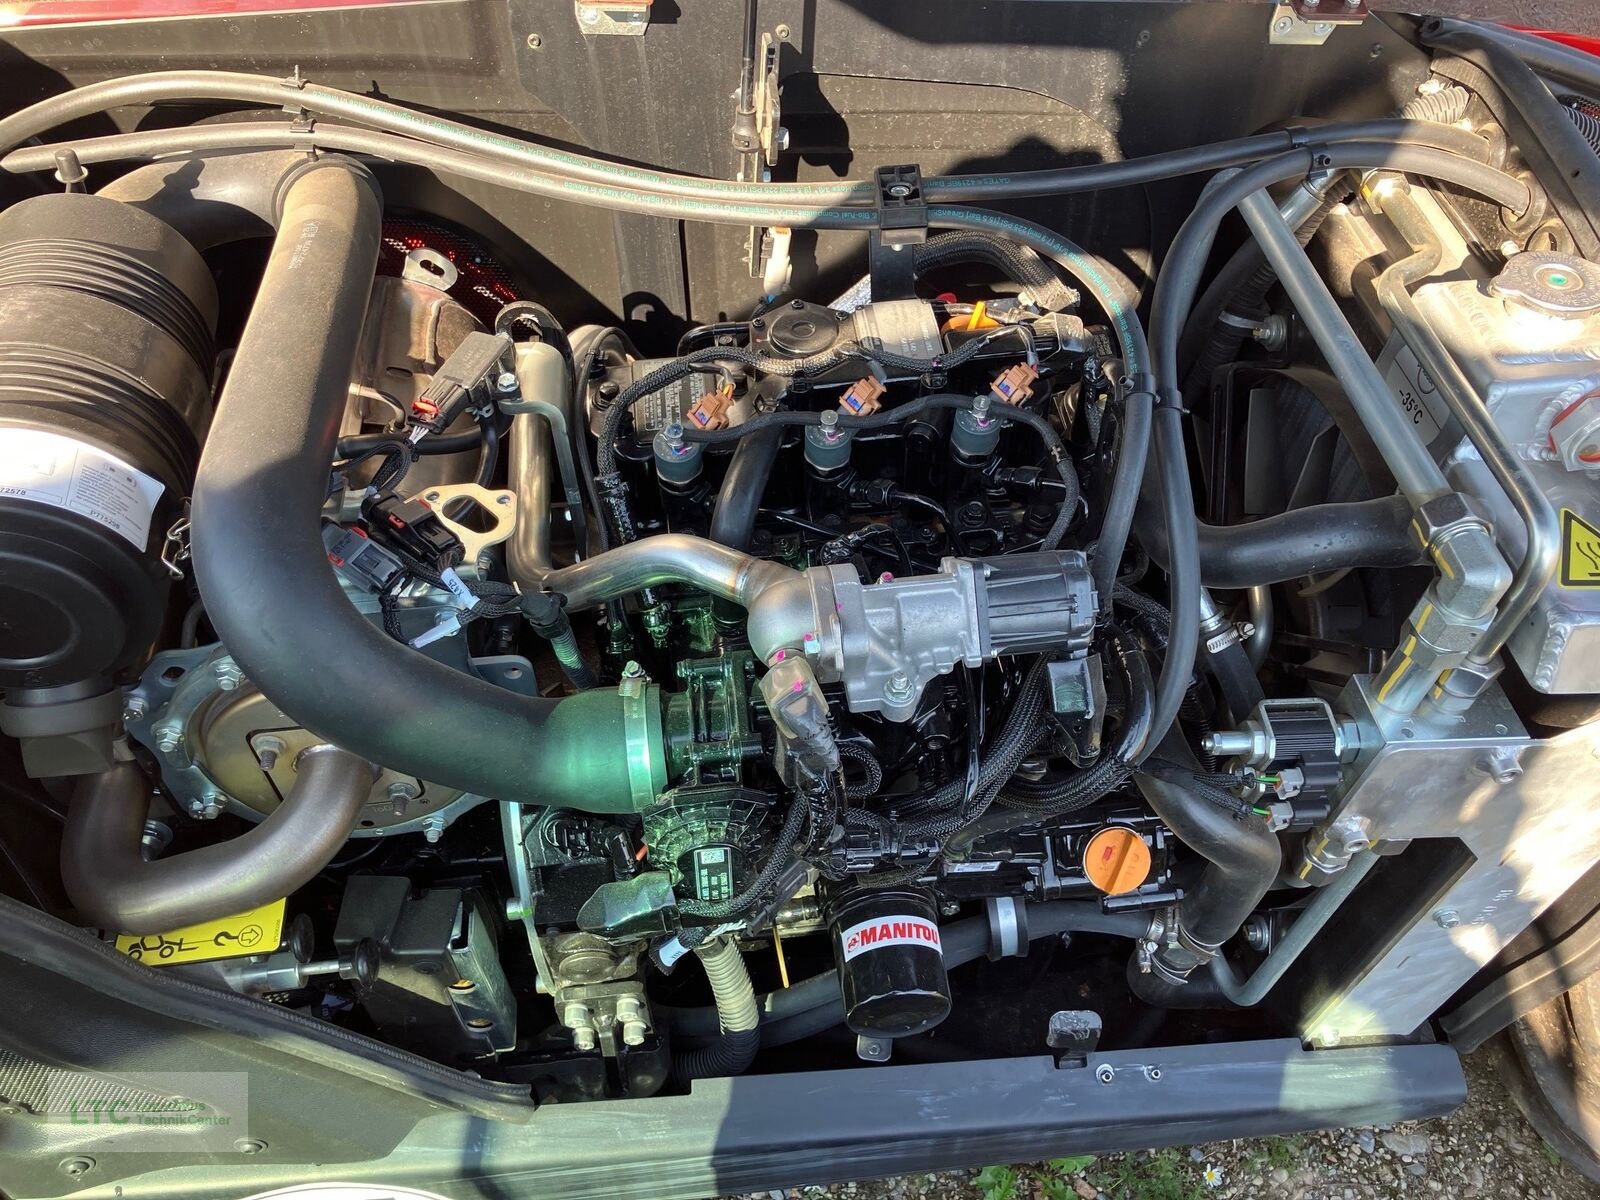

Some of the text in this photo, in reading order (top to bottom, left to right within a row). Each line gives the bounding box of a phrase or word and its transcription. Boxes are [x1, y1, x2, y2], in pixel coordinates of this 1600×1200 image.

[1399, 390, 1423, 425] -35°C
[448, 578, 464, 597] X425
[860, 922, 938, 946] MANITOU
